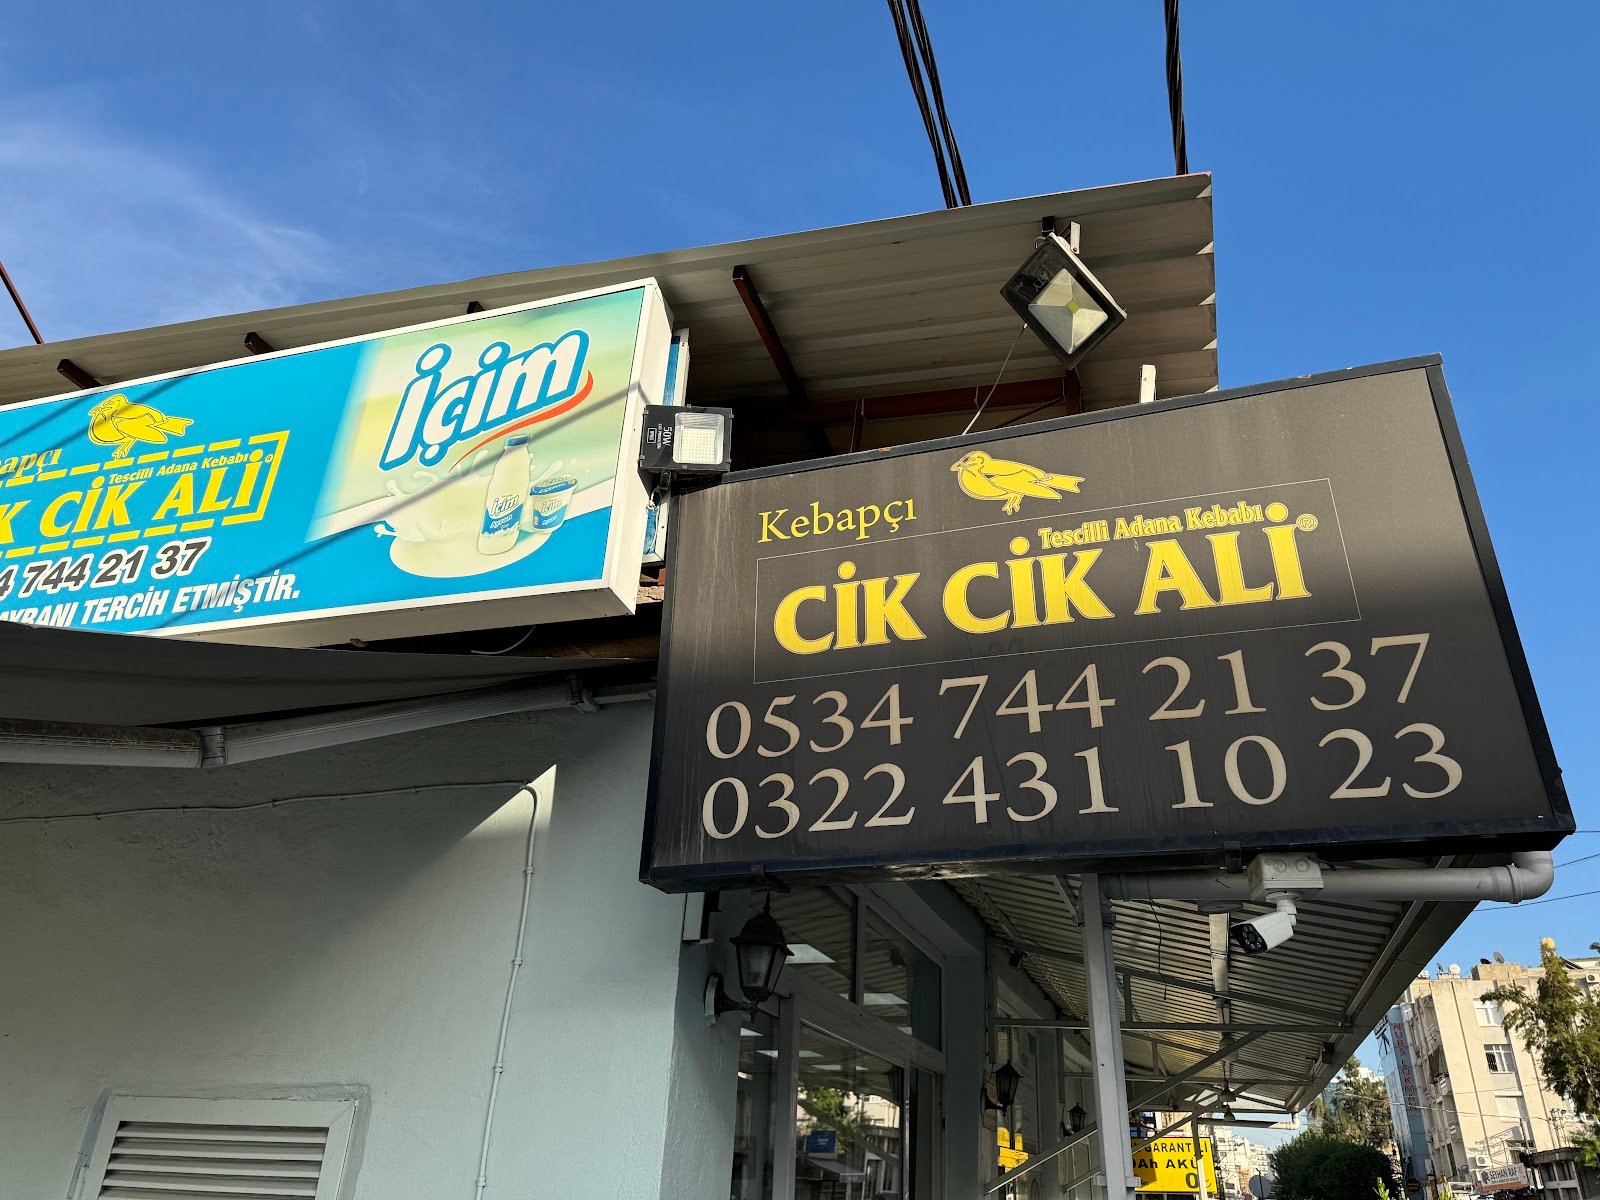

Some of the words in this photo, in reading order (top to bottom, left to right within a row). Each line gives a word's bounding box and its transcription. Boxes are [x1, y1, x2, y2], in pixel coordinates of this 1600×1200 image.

[0, 448, 62, 479] apçı
[662, 426, 673, 447] 50W
[109, 469, 153, 485] Tescilli
[156, 461, 197, 477] Adana
[201, 453, 248, 469] Kebabı
[39, 476, 146, 538] CİK
[757, 499, 918, 543] Kebapçı
[1038, 520, 1110, 549] Tescilli
[1114, 514, 1183, 540] Adana
[1184, 501, 1265, 531] Kebabı
[19, 554, 93, 598] 744
[91, 545, 147, 588] 21
[152, 537, 211, 582] 37
[773, 561, 927, 655] CİK
[943, 536, 1116, 634] CİK
[81, 587, 169, 625] TERCİH
[172, 569, 300, 614] ETMİŞTİR.
[706, 683, 914, 760] 0534
[938, 663, 1116, 740] 744
[1142, 649, 1267, 721] 21
[1304, 633, 1430, 711] 37
[702, 762, 916, 839] 0322
[942, 746, 1119, 824] 431
[1164, 735, 1287, 809] 10
[1318, 722, 1463, 799] 23
